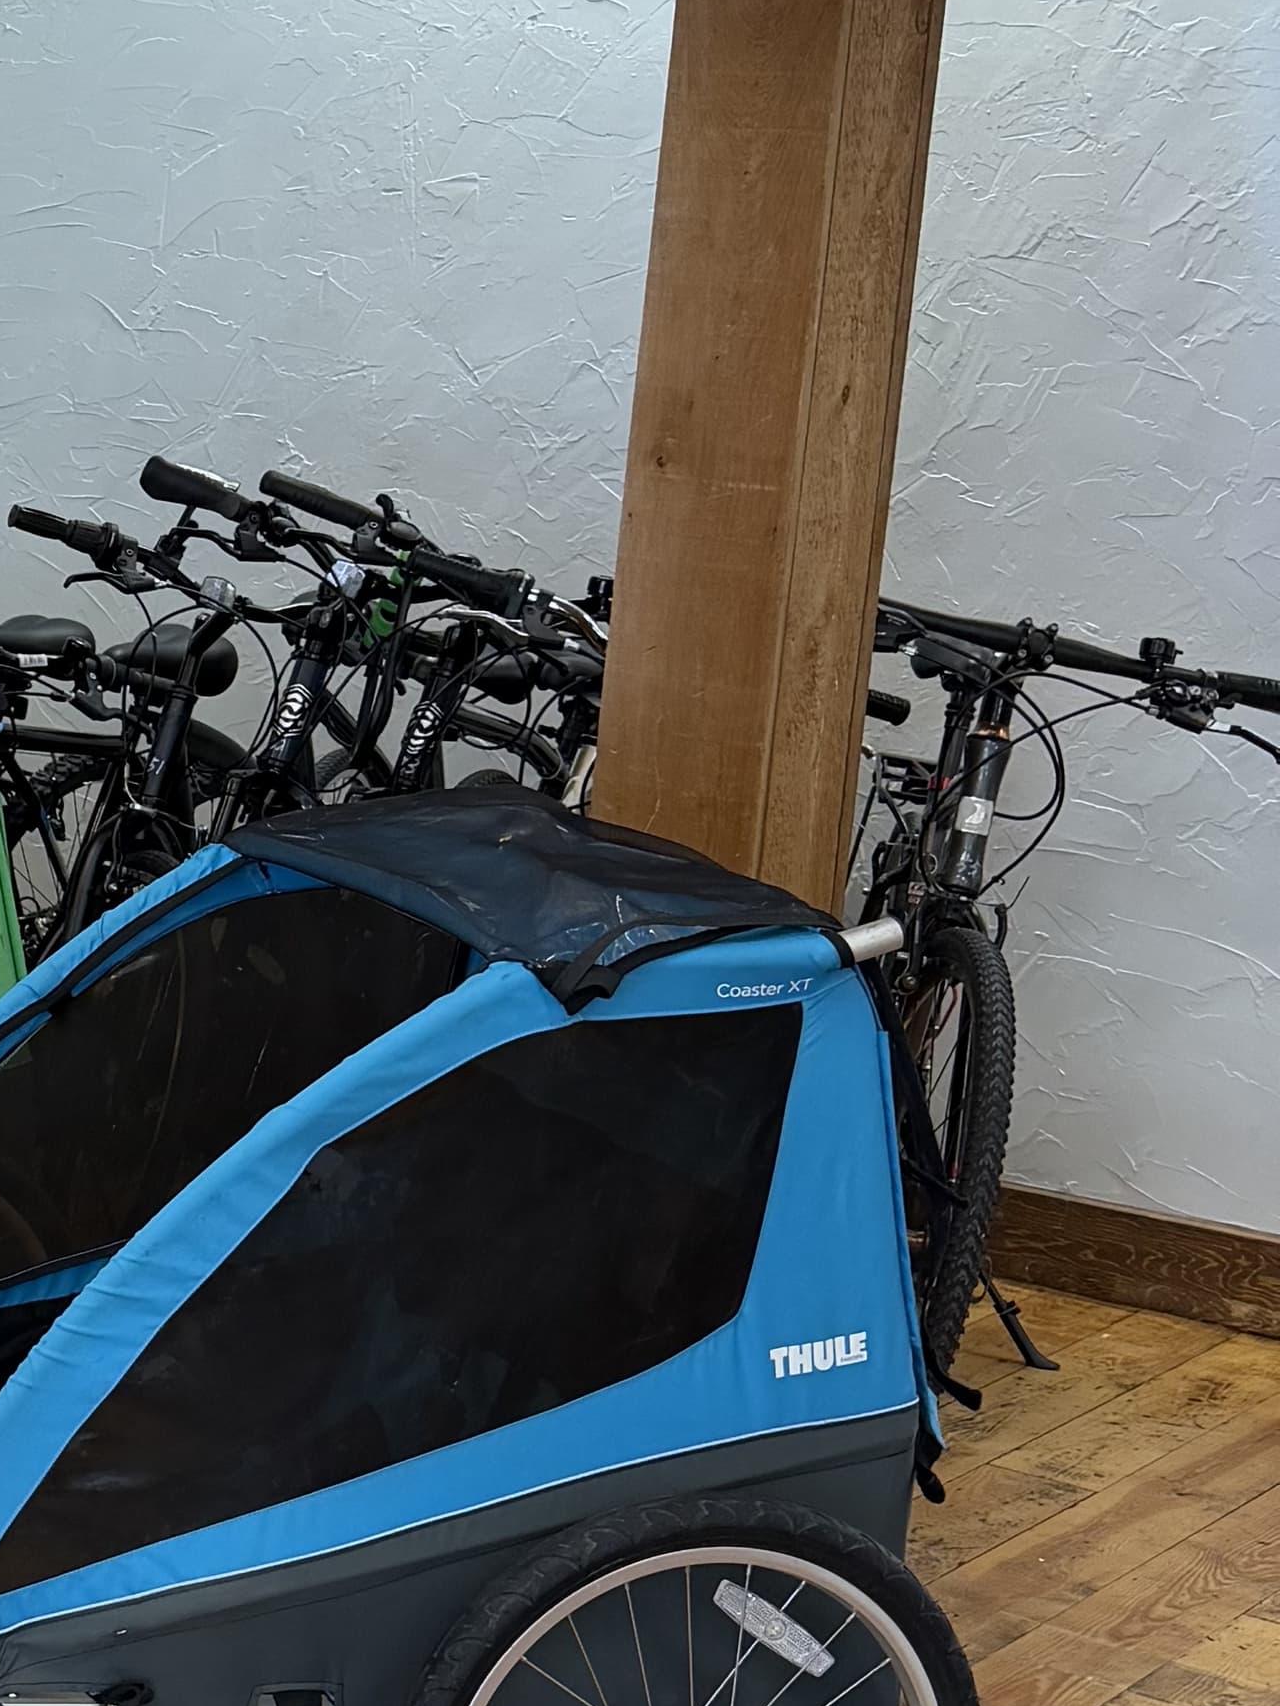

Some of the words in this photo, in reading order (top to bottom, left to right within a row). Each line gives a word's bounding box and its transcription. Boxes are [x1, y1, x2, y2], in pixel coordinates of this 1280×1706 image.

[716, 983, 785, 998] Coaster
[787, 977, 815, 994] XT
[769, 1331, 868, 1379] THULE
